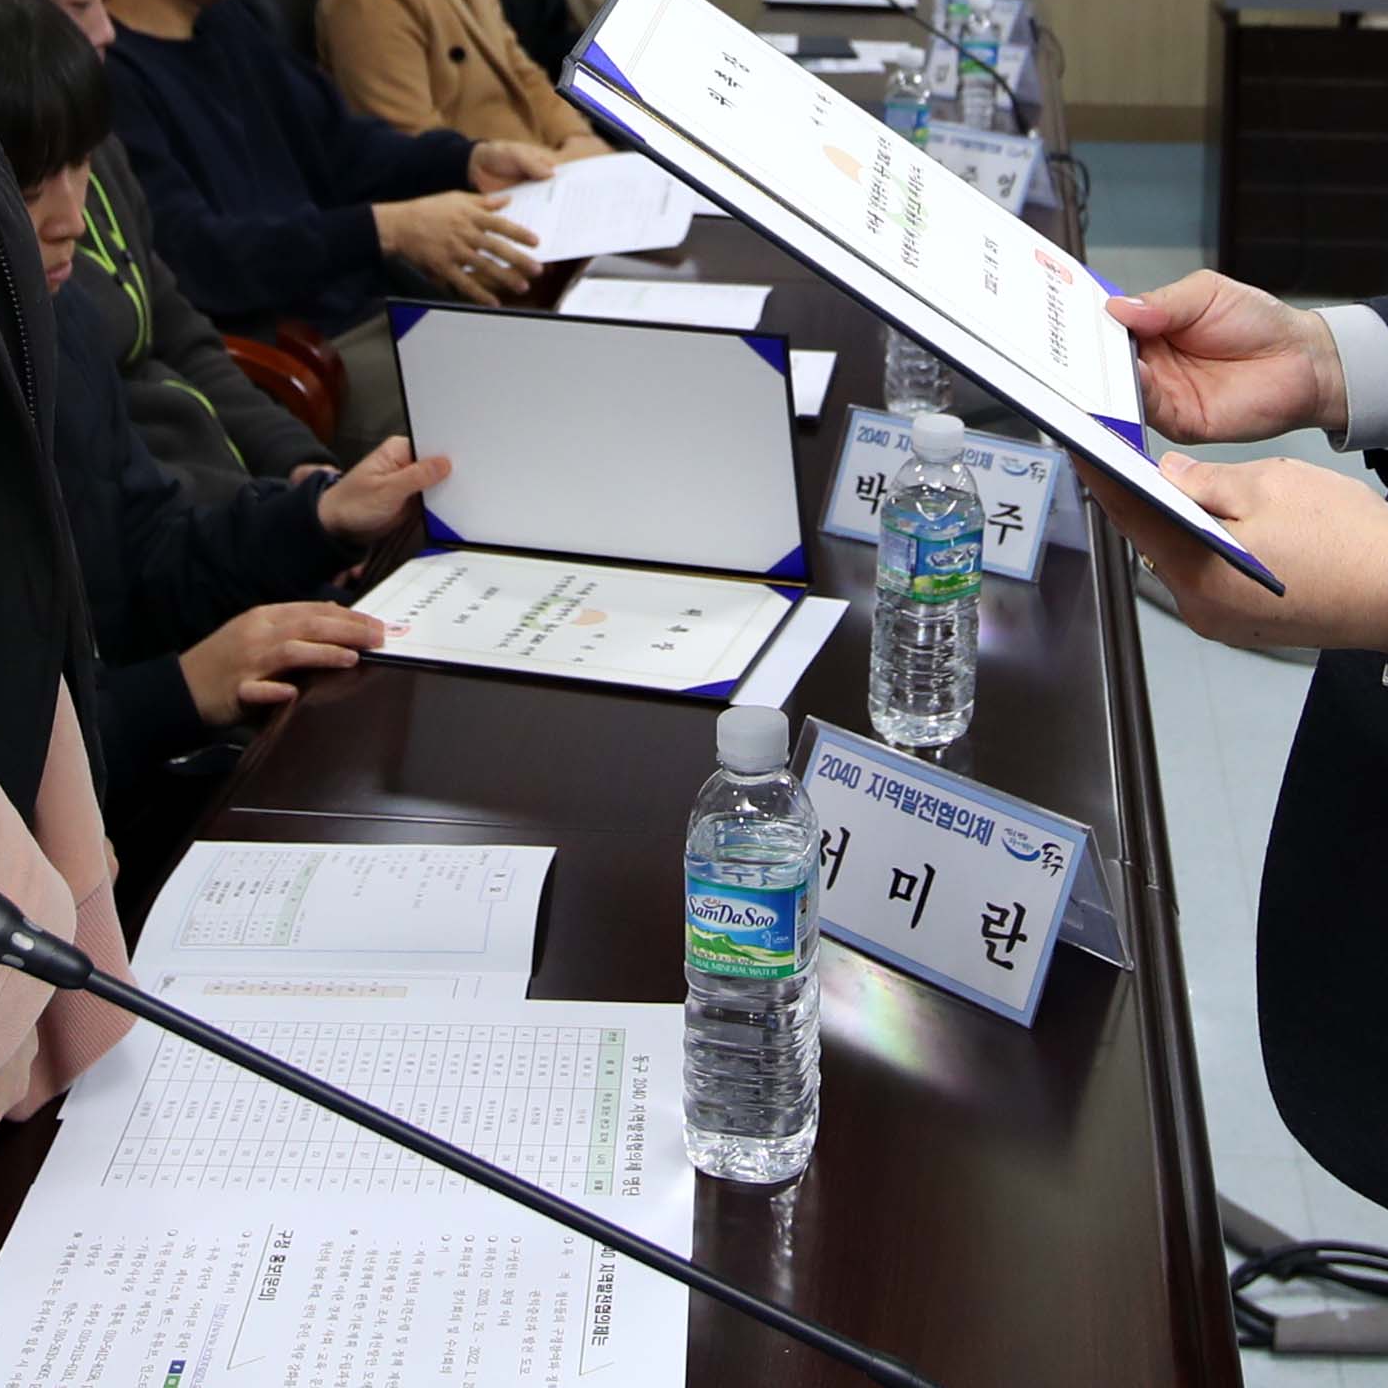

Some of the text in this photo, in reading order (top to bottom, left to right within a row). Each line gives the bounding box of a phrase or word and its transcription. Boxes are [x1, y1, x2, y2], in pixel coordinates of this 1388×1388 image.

[856, 472, 1024, 546] 박 주
[818, 754, 863, 790] 2040
[865, 772, 996, 847] 지역발전협의체
[689, 895, 775, 928] SamDaSoo
[889, 863, 937, 930] 미
[981, 901, 1028, 971] 란
[622, 1055, 649, 1196] 동구 2040 지역발전협의체 명단
[273, 1230, 294, 1249] 구정
[591, 1264, 616, 1346] 지역발전협의체는
